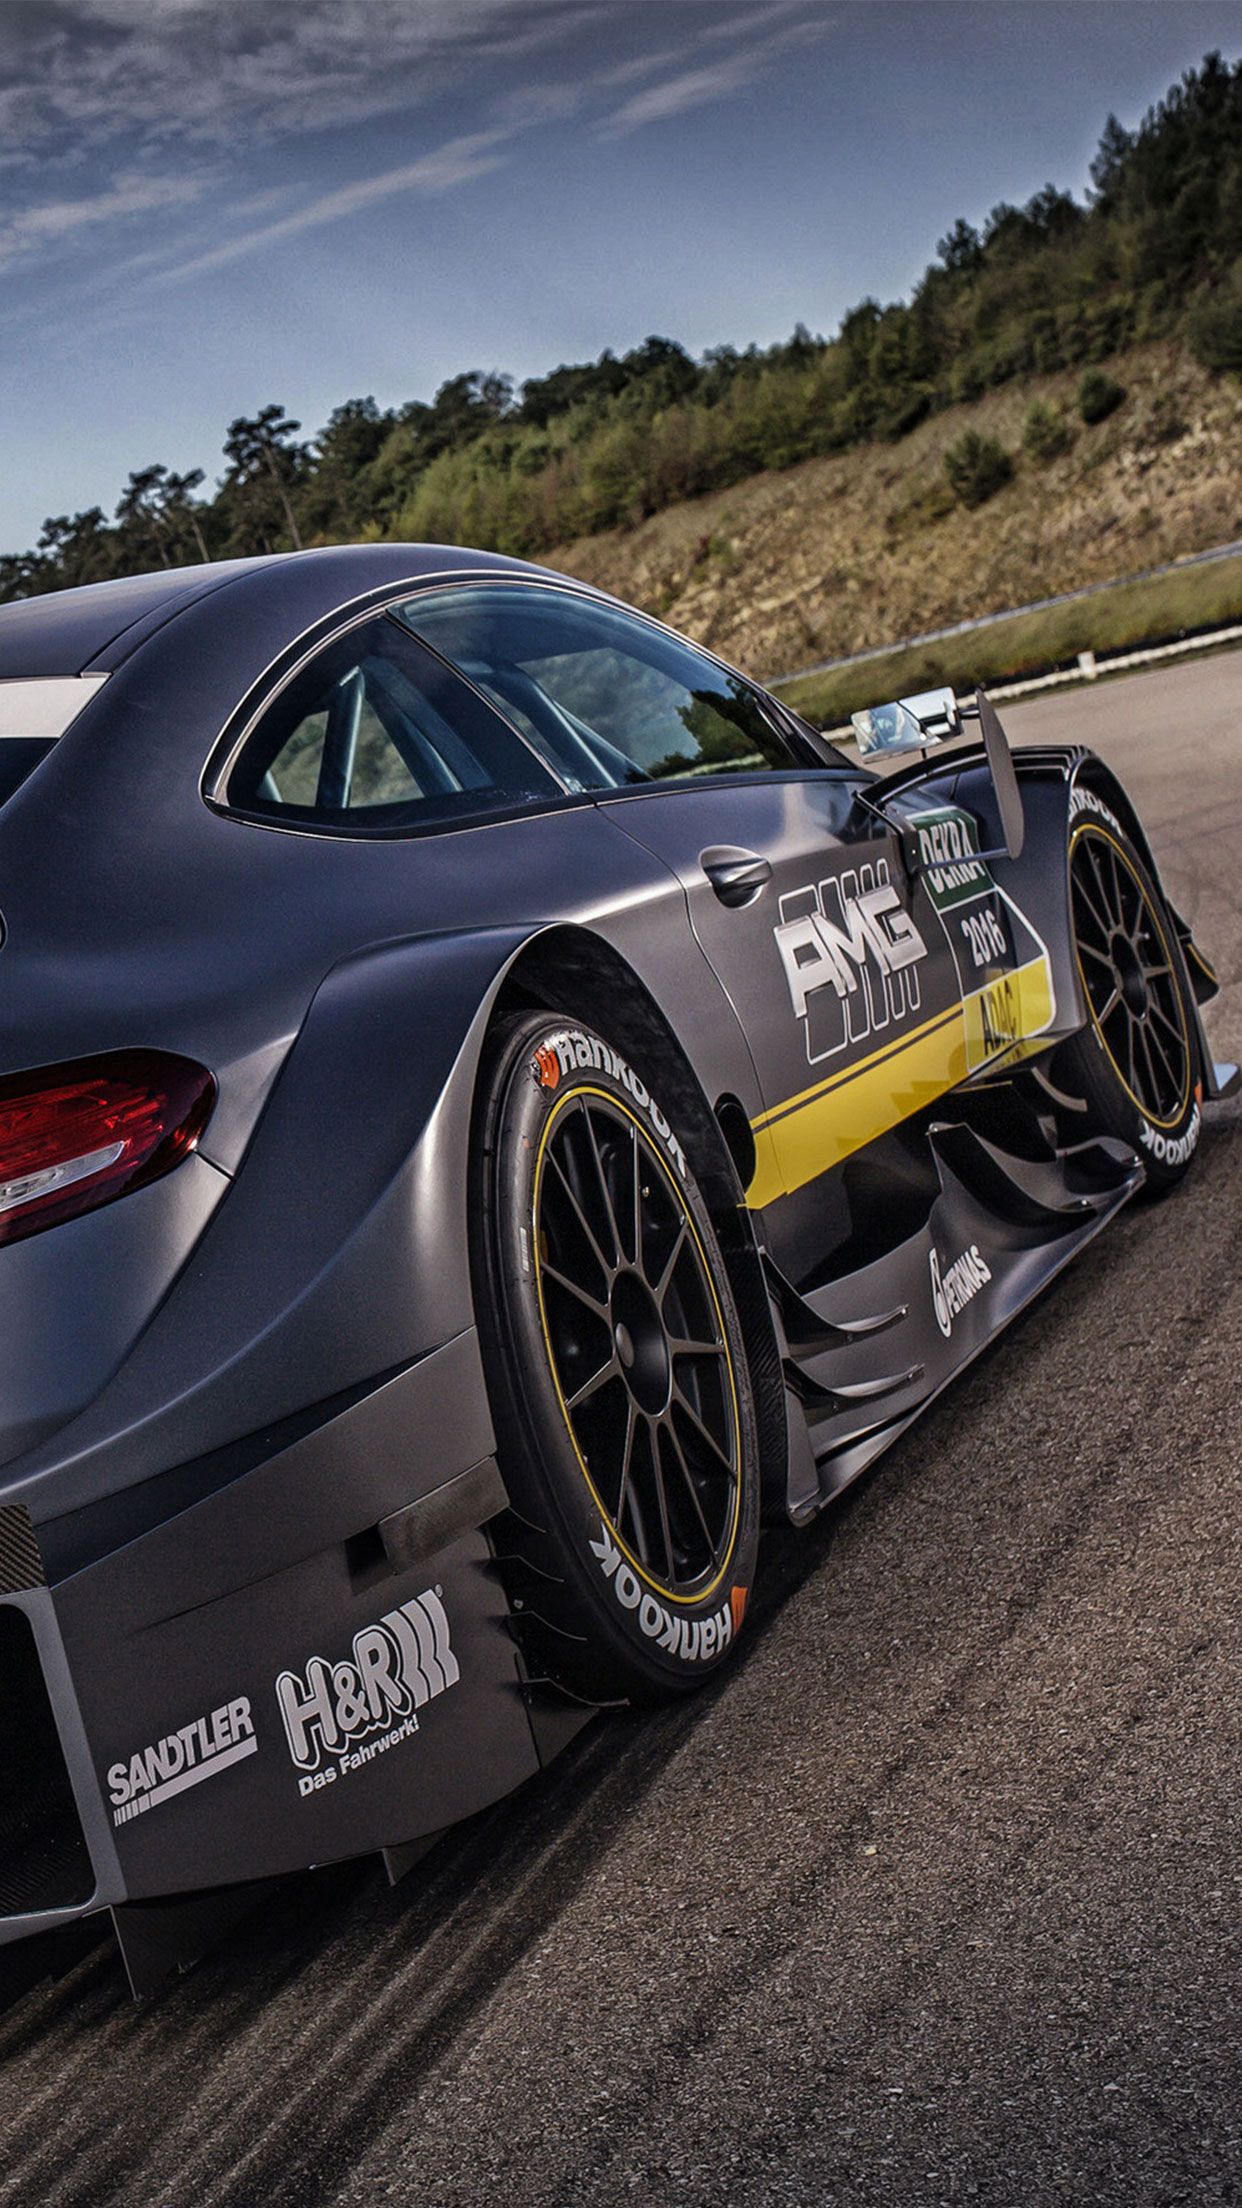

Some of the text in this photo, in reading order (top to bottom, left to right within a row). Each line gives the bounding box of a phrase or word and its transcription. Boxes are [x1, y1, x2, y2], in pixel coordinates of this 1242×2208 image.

[918, 817, 986, 894] DEKRA
[1068, 788, 1123, 837] nkook
[773, 885, 928, 1020] AMG
[961, 909, 1007, 967] 2016
[551, 1029, 688, 1179] Hankook
[942, 1245, 992, 1318] PETRONAS
[588, 1521, 732, 1660] Hankook
[275, 1624, 412, 1771] H&R
[107, 1696, 255, 1805] SANDTLER
[298, 1714, 420, 1797] Das Fahrwerk!
